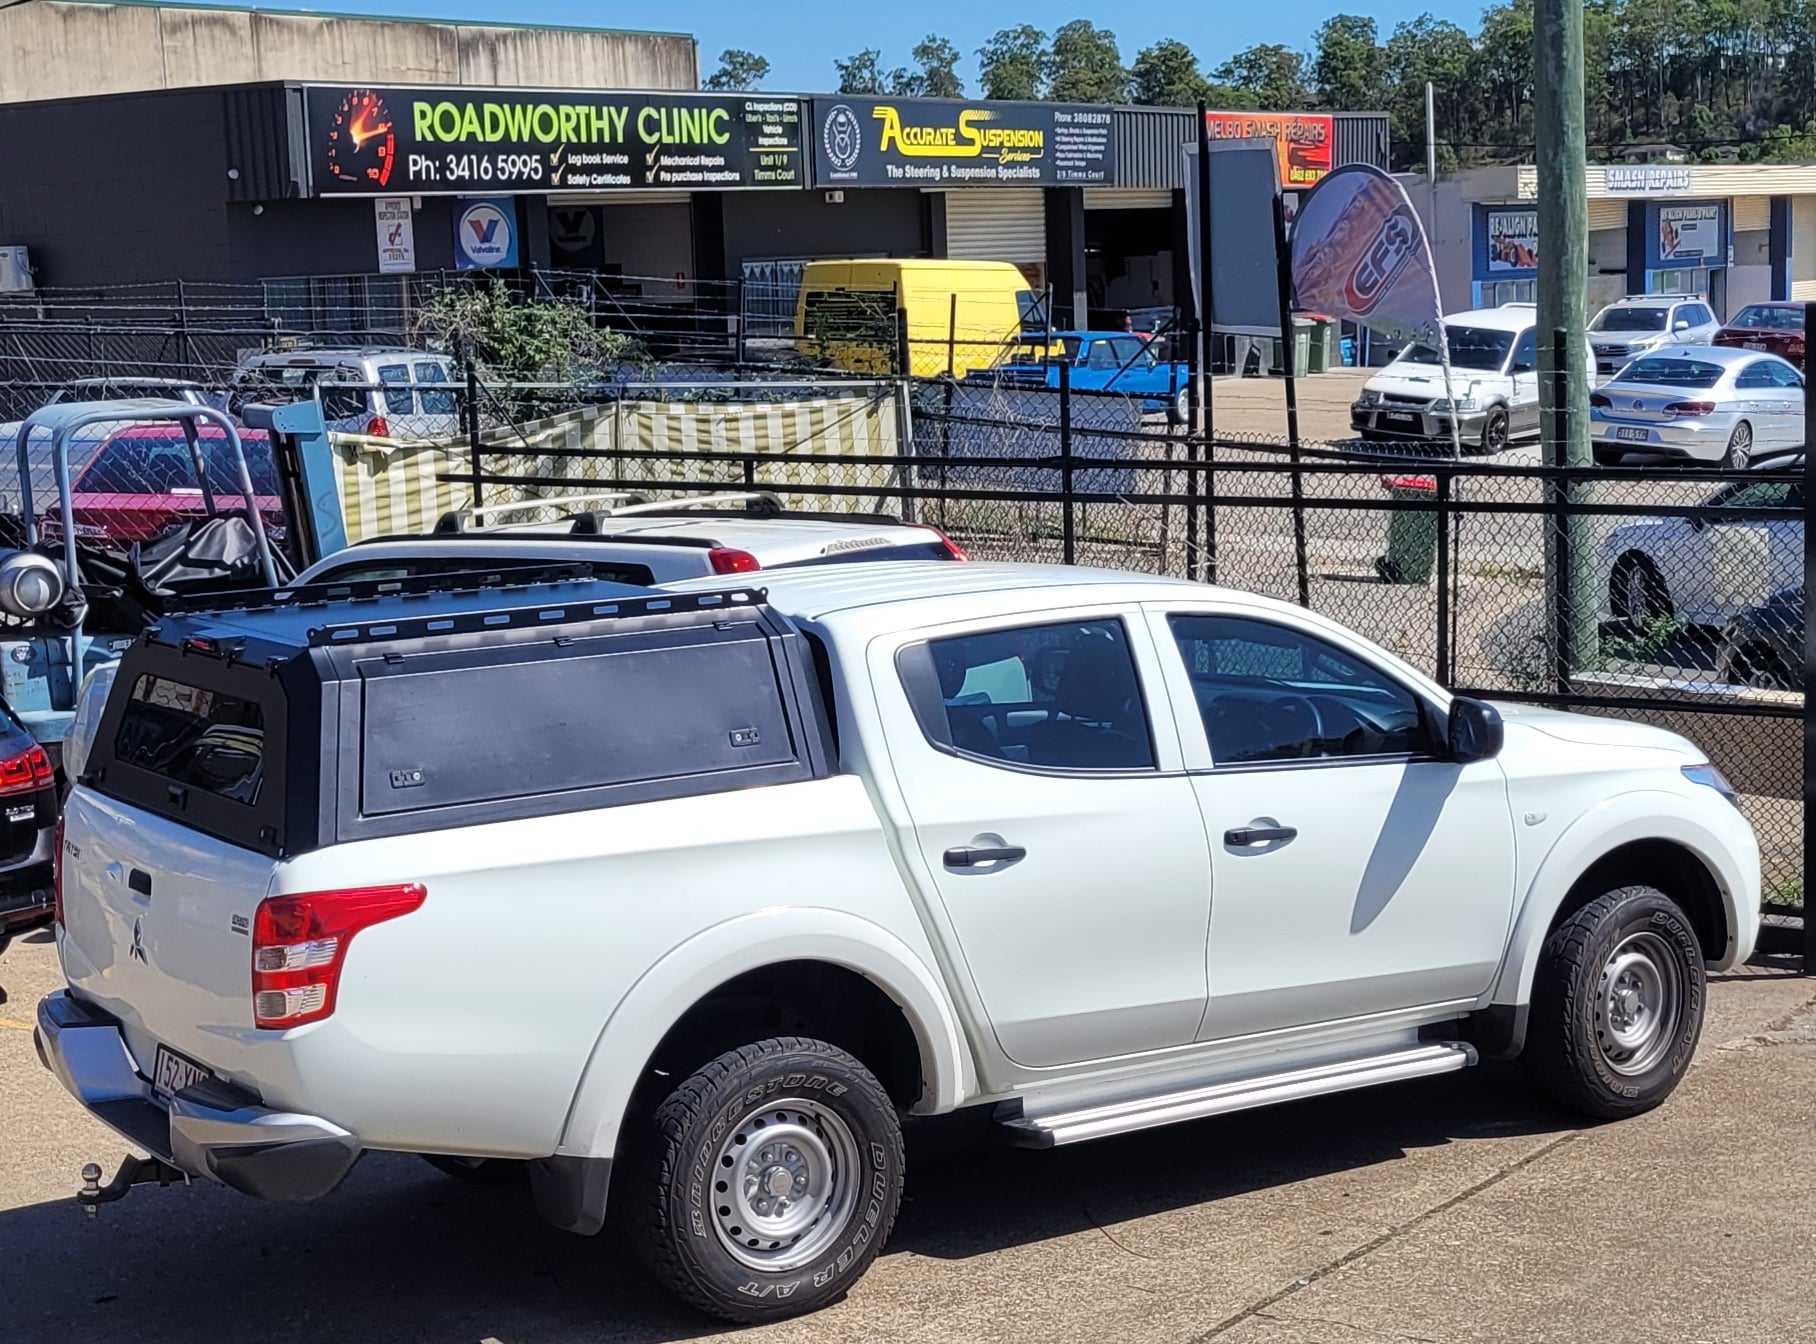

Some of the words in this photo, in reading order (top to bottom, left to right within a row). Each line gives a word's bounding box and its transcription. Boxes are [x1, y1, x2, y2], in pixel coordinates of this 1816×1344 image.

[413, 101, 629, 143] ROADWORTHY
[637, 106, 730, 144] CLINIC
[872, 106, 957, 152] ACCURATE
[959, 109, 1044, 156] SUSPENSION
[1285, 122, 1326, 141] REPAIRS
[408, 155, 440, 180] Ph:
[446, 155, 492, 180] 3416
[497, 155, 542, 181] 5995
[568, 154, 582, 167] Log
[583, 154, 601, 165] book
[602, 154, 629, 166] Service
[660, 156, 699, 166] Mechanical
[700, 156, 725, 167] Repairs
[567, 174, 590, 187] Safety
[591, 174, 631, 186] Certificates
[703, 172, 740, 182] Inspections
[776, 169, 795, 180] Court
[886, 165, 904, 178] The
[905, 165, 940, 180] Steering
[942, 166, 949, 178] &
[950, 166, 996, 181] Suspension
[998, 166, 1040, 181] Specialists
[1607, 169, 1646, 190] SMASH
[1648, 169, 1691, 190] REPAIRS
[471, 246, 501, 255] Valvoline
[814, 1141, 886, 1288] DUELER
